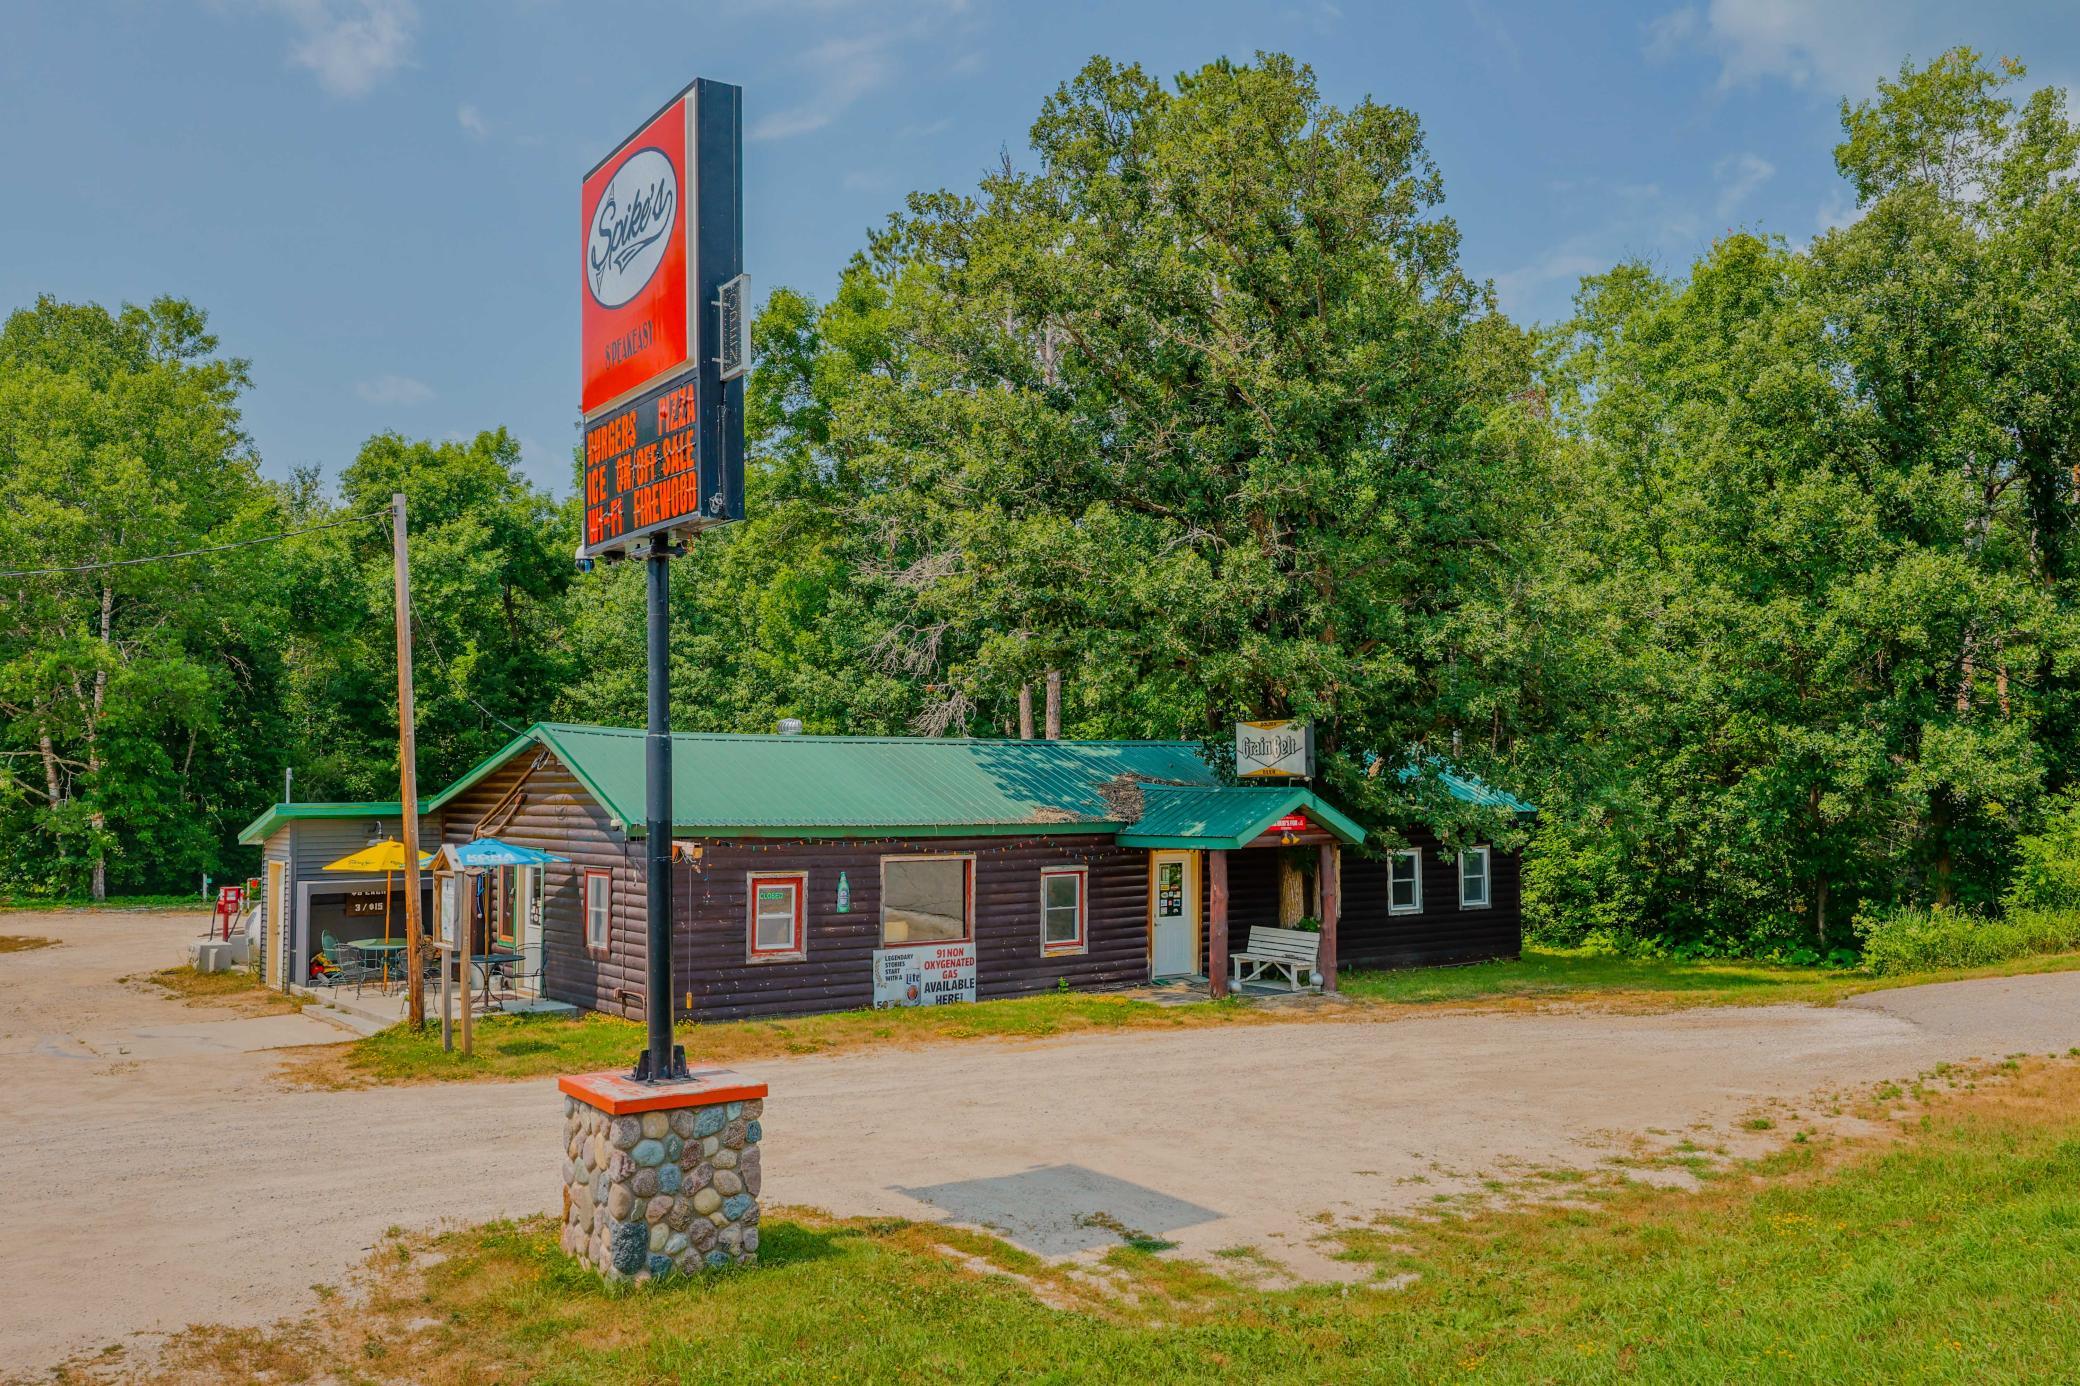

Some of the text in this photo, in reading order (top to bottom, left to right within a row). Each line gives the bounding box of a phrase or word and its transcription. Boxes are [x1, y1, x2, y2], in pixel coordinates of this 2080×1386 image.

[591, 178, 673, 271] Spike's
[728, 293, 738, 361] OPEN
[605, 319, 654, 371] SPEAKEASY
[587, 383, 697, 468] BURGERS PIZZA
[587, 464, 607, 506] ICE
[662, 428, 695, 477] SALE
[587, 471, 697, 544] WI-FI FIREWOOD
[1242, 736, 1296, 759] Grain Belt
[760, 892, 784, 900] CLOSED
[885, 953, 913, 961] LEGENDARY
[937, 948, 964, 958] 91 NON
[924, 958, 975, 970] OXYGENATED
[906, 973, 920, 985] Lite
[942, 969, 958, 979] GAS
[924, 978, 975, 993] AVAILABLE
